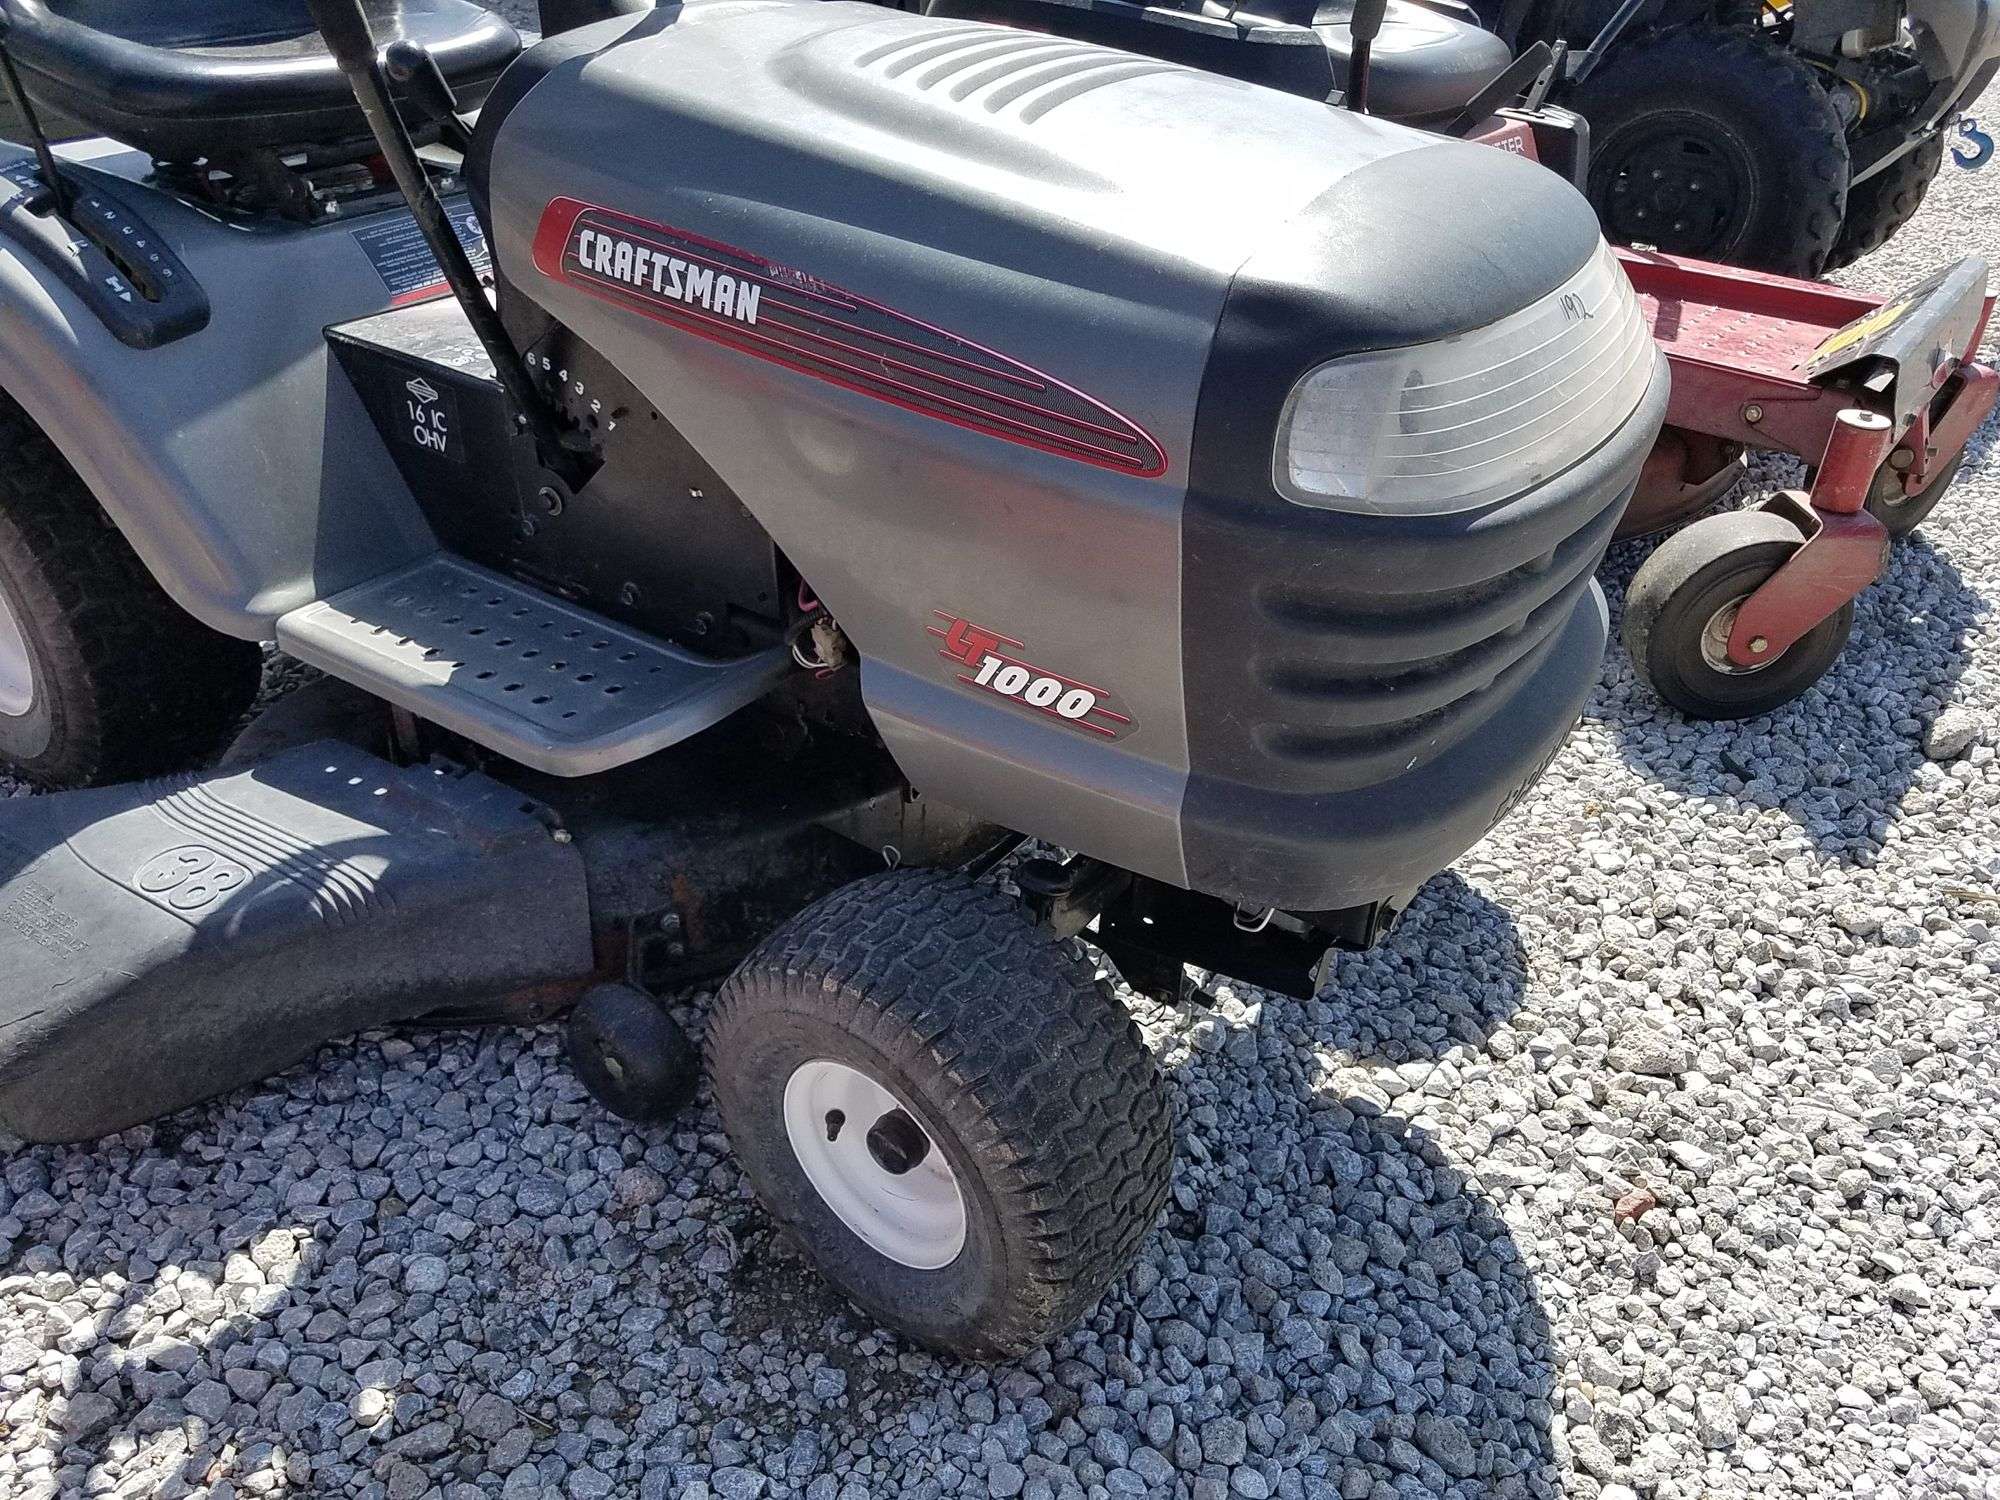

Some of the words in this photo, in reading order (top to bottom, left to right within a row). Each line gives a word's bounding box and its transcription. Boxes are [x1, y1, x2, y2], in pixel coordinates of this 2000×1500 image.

[578, 229, 761, 325] CRAFTSMAN
[1559, 292, 1594, 320] 192
[527, 352, 536, 366] 6
[542, 358, 551, 371] 5
[559, 369, 568, 382] 4
[575, 382, 584, 395] 3
[406, 400, 426, 424] 16
[430, 409, 448, 432] IC
[591, 399, 601, 413] 2
[413, 425, 447, 452] OHV
[946, 619, 998, 667] LT
[974, 655, 1096, 719] 1000
[139, 849, 247, 910] 38
